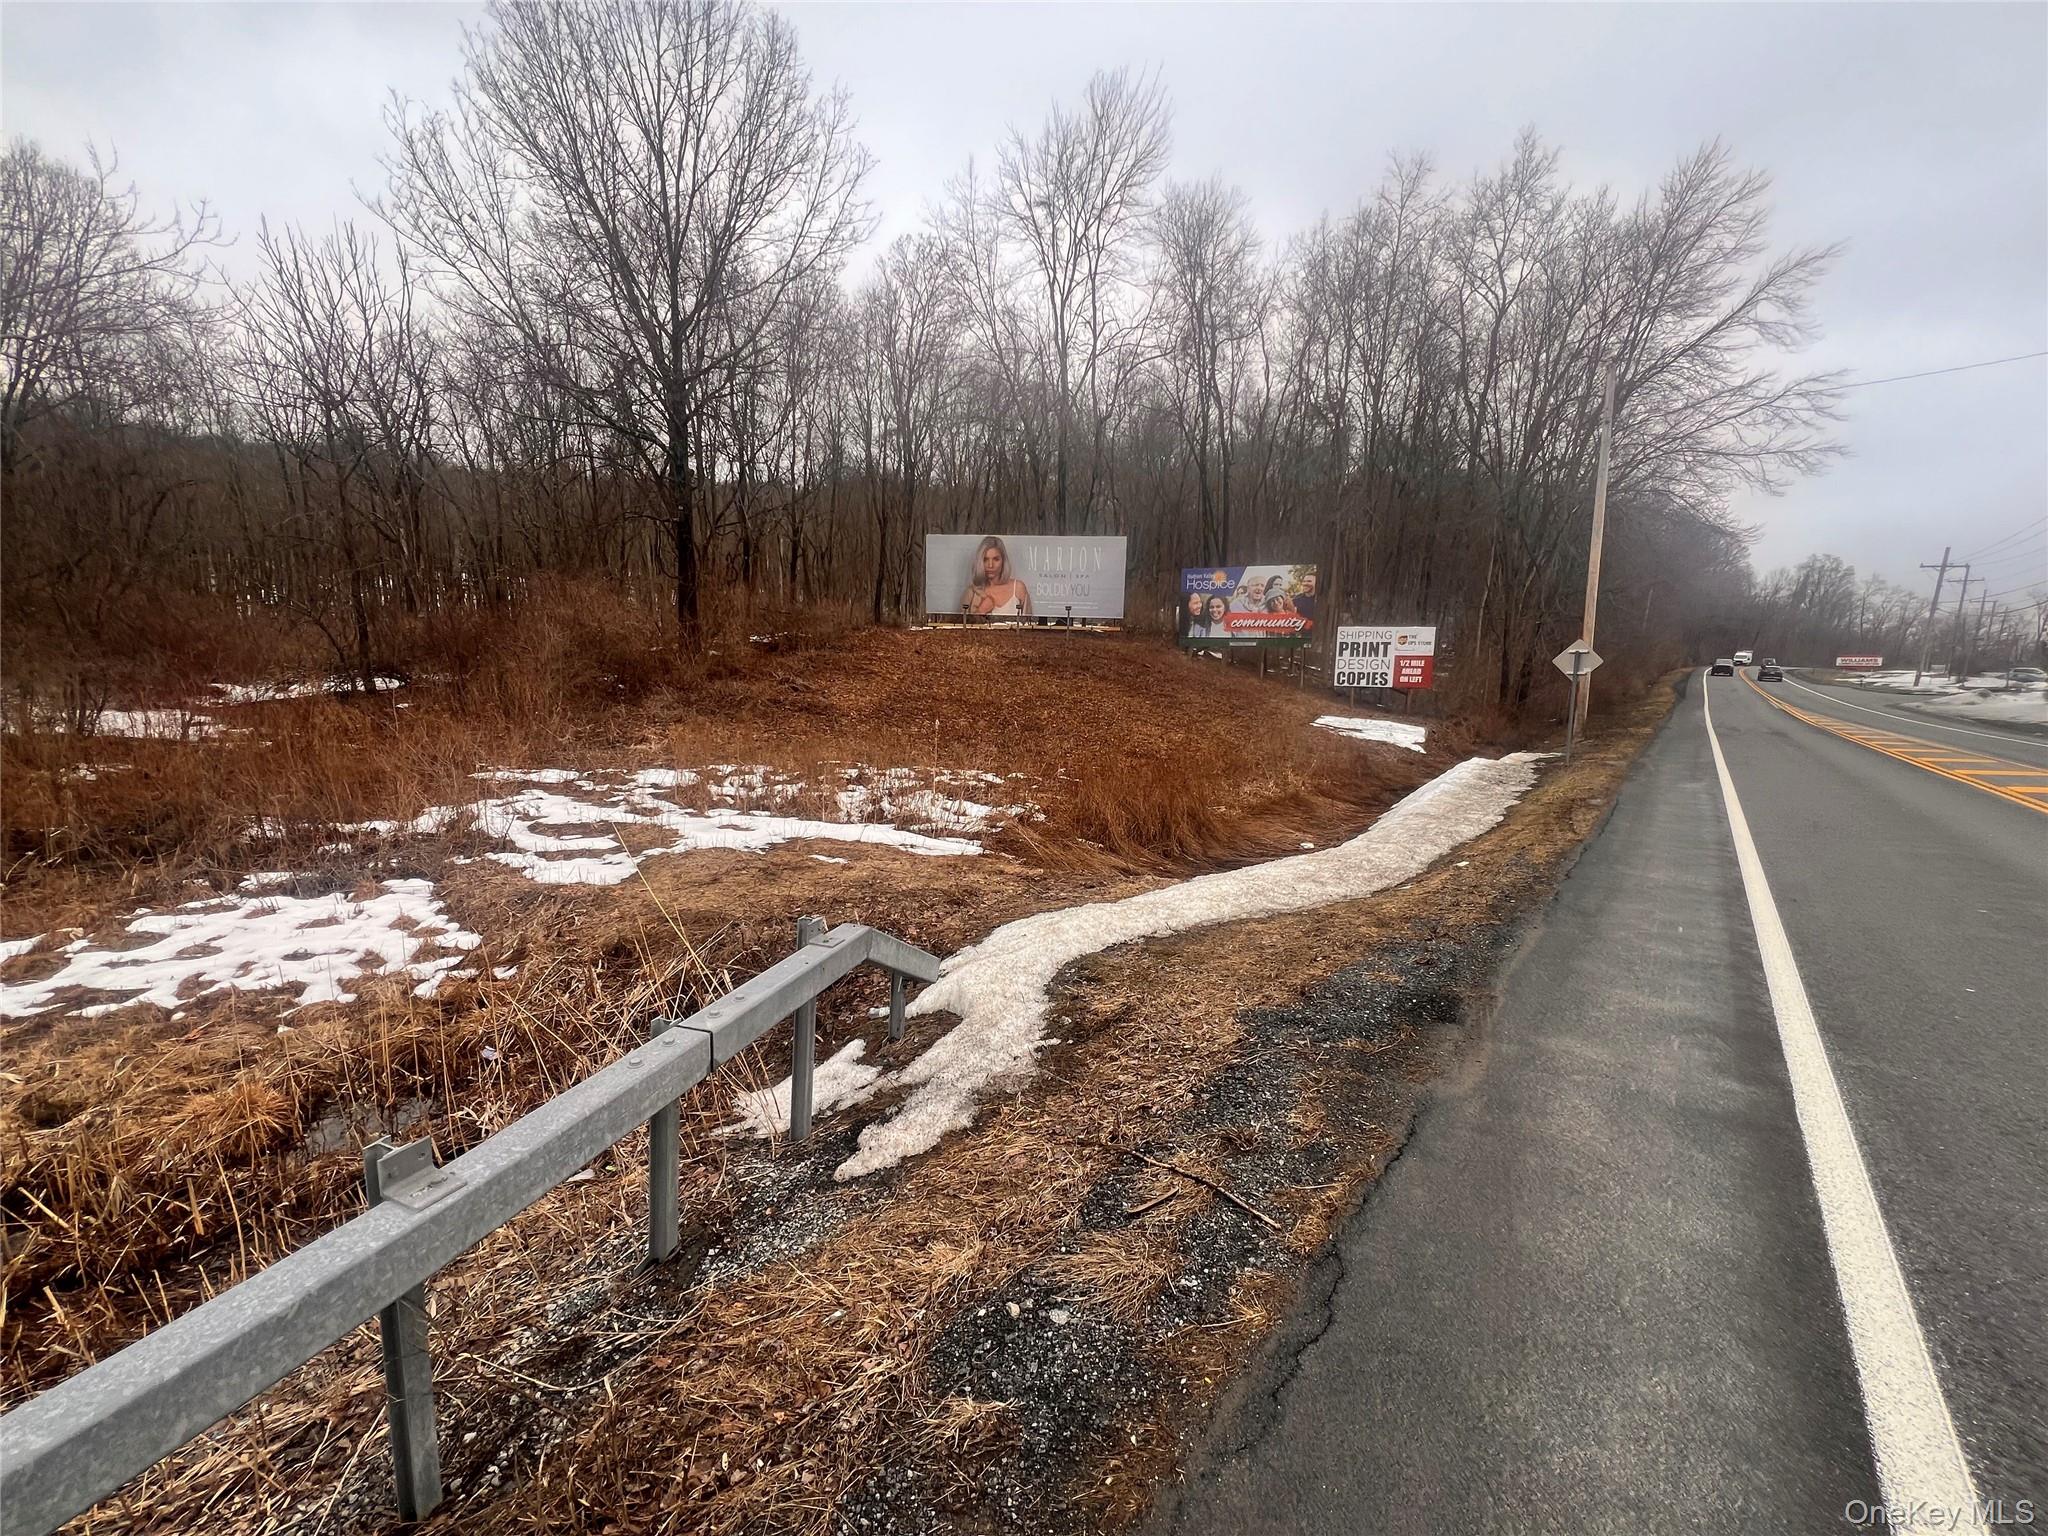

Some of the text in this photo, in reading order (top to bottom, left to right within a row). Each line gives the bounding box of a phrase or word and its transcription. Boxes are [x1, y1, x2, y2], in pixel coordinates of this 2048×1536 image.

[1028, 545, 1102, 571] MARION
[1186, 579, 1236, 591] Hospice
[1231, 617, 1306, 631] community
[1339, 630, 1393, 640] SHIPPING
[1338, 641, 1392, 658] PRINT
[1337, 658, 1391, 671] DESIGN
[1336, 671, 1389, 687] COPIES
